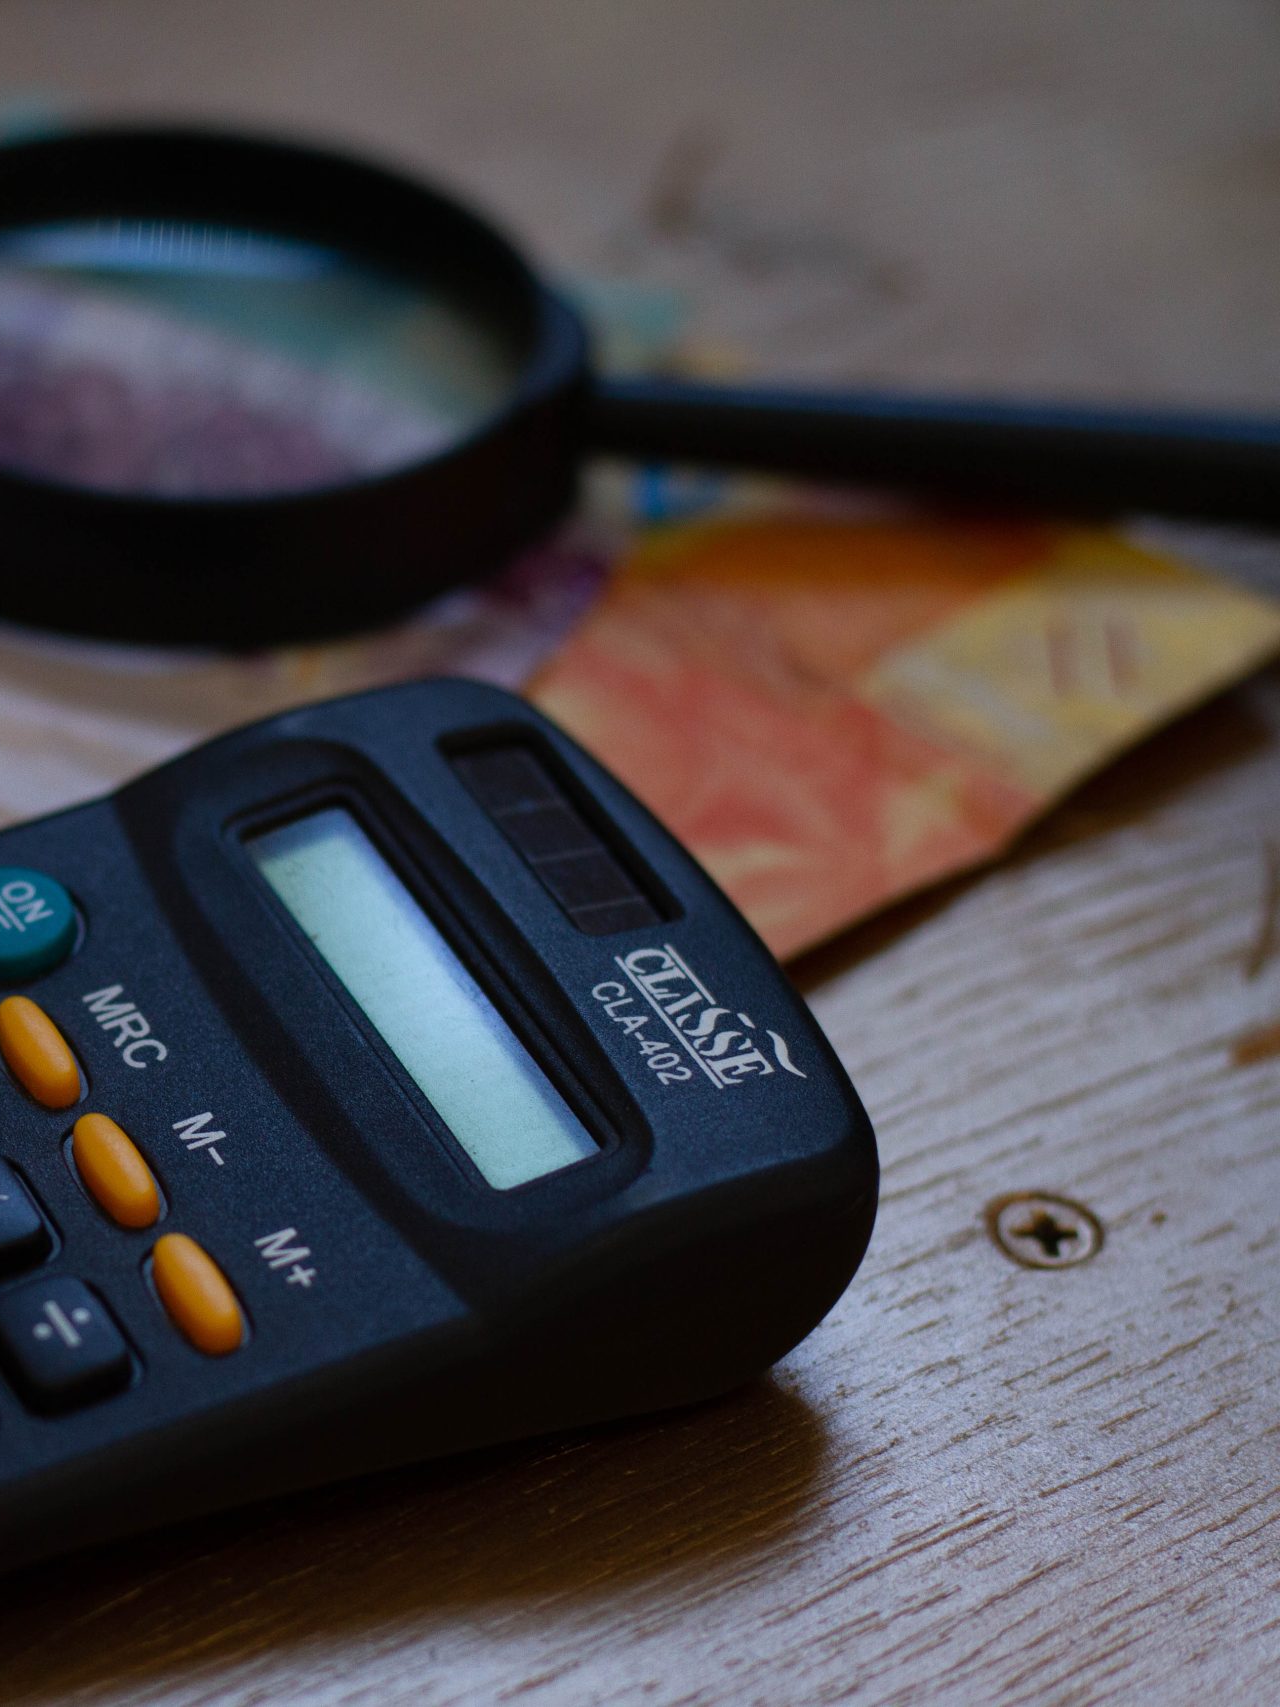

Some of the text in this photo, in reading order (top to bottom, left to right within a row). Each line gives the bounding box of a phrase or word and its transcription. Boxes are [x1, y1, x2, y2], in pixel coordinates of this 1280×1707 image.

[2, 880, 54, 925] ON
[82, 984, 168, 1069] MRC
[591, 980, 693, 1086] CLA-402
[254, 1227, 316, 1286] M+
